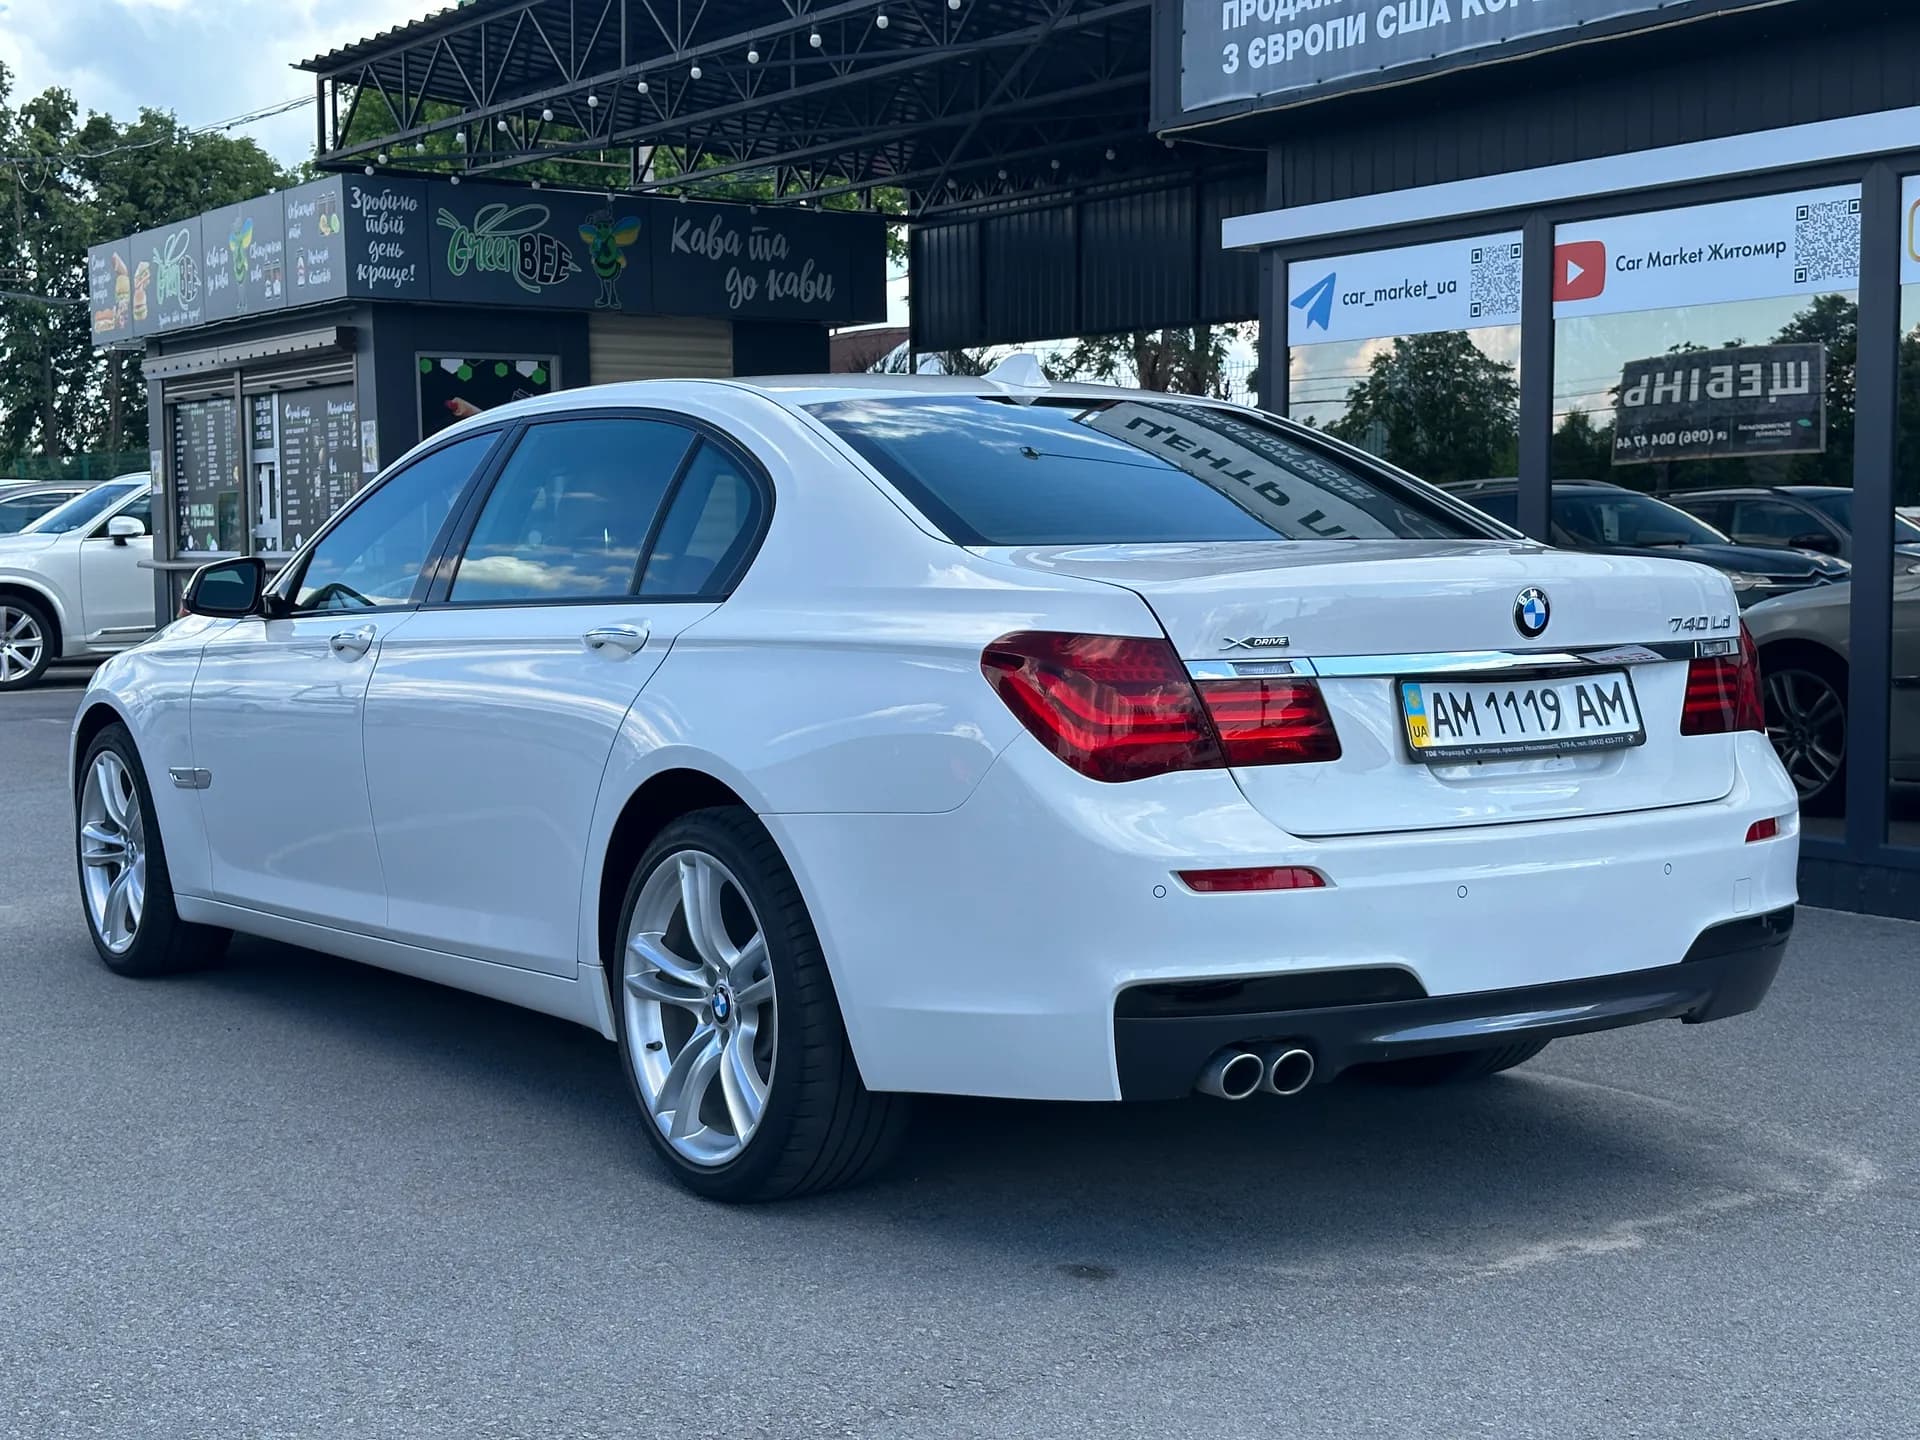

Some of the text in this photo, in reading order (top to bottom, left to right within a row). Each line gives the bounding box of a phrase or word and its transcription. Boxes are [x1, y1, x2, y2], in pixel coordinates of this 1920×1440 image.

[1222, 43, 1240, 74] З
[1247, 12, 1367, 70] ЄВРОПИ
[1376, 0, 1452, 39] США
[351, 186, 418, 217] Зробимо
[365, 211, 406, 236] твій
[671, 214, 791, 262] Кава та
[368, 240, 405, 263] день
[1615, 238, 1788, 273] Car Market Житомир
[356, 264, 416, 290] краще!
[725, 257, 836, 310] до кави
[1342, 279, 1458, 309] car_market_ua
[1433, 681, 1629, 738] AM 1119 AM
[1413, 725, 1428, 739] UA
